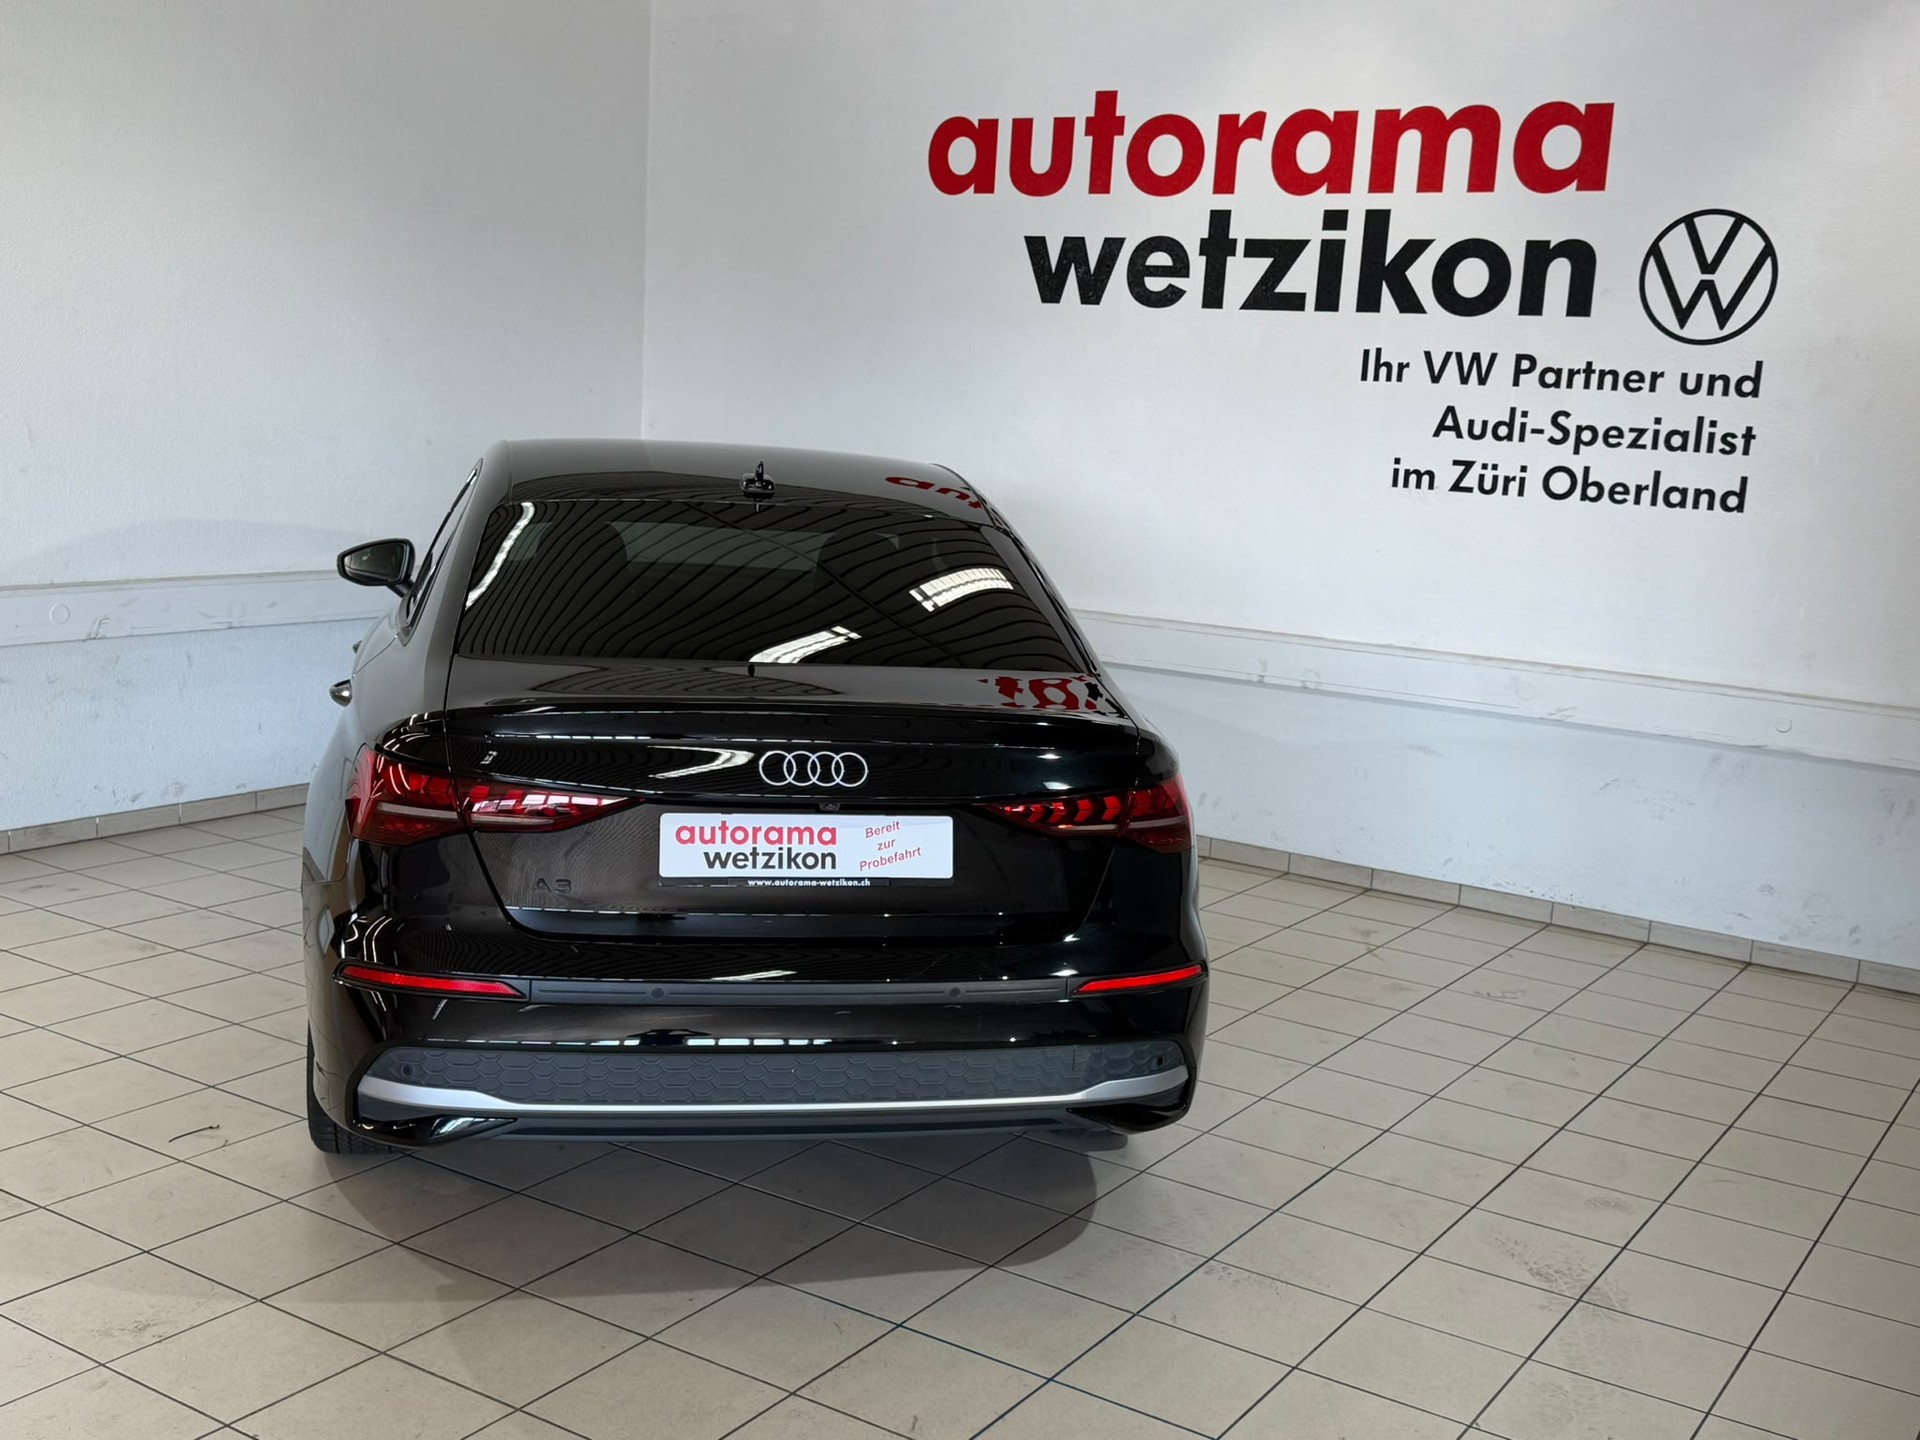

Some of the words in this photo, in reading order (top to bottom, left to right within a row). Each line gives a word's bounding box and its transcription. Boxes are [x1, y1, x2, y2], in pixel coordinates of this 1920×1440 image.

[927, 90, 1615, 197] autorama
[1024, 209, 1597, 317] wetzikon
[1360, 348, 1411, 382] Ihr
[1424, 351, 1499, 386] VW
[1512, 354, 1665, 393] Partner
[1680, 361, 1764, 398] und
[1432, 405, 1757, 457] Audi-Spezialist
[1392, 458, 1436, 490] im
[1449, 460, 1528, 497] Züri
[1542, 466, 1749, 513] Oberland
[675, 820, 837, 846] autorama
[865, 821, 900, 838] Bereit
[877, 839, 896, 850] zur
[704, 847, 837, 870] wetzikon
[859, 846, 922, 871] Probefahrt
[531, 877, 572, 894] A3
[747, 878, 871, 887] www.autorama-wetzikon.ch
